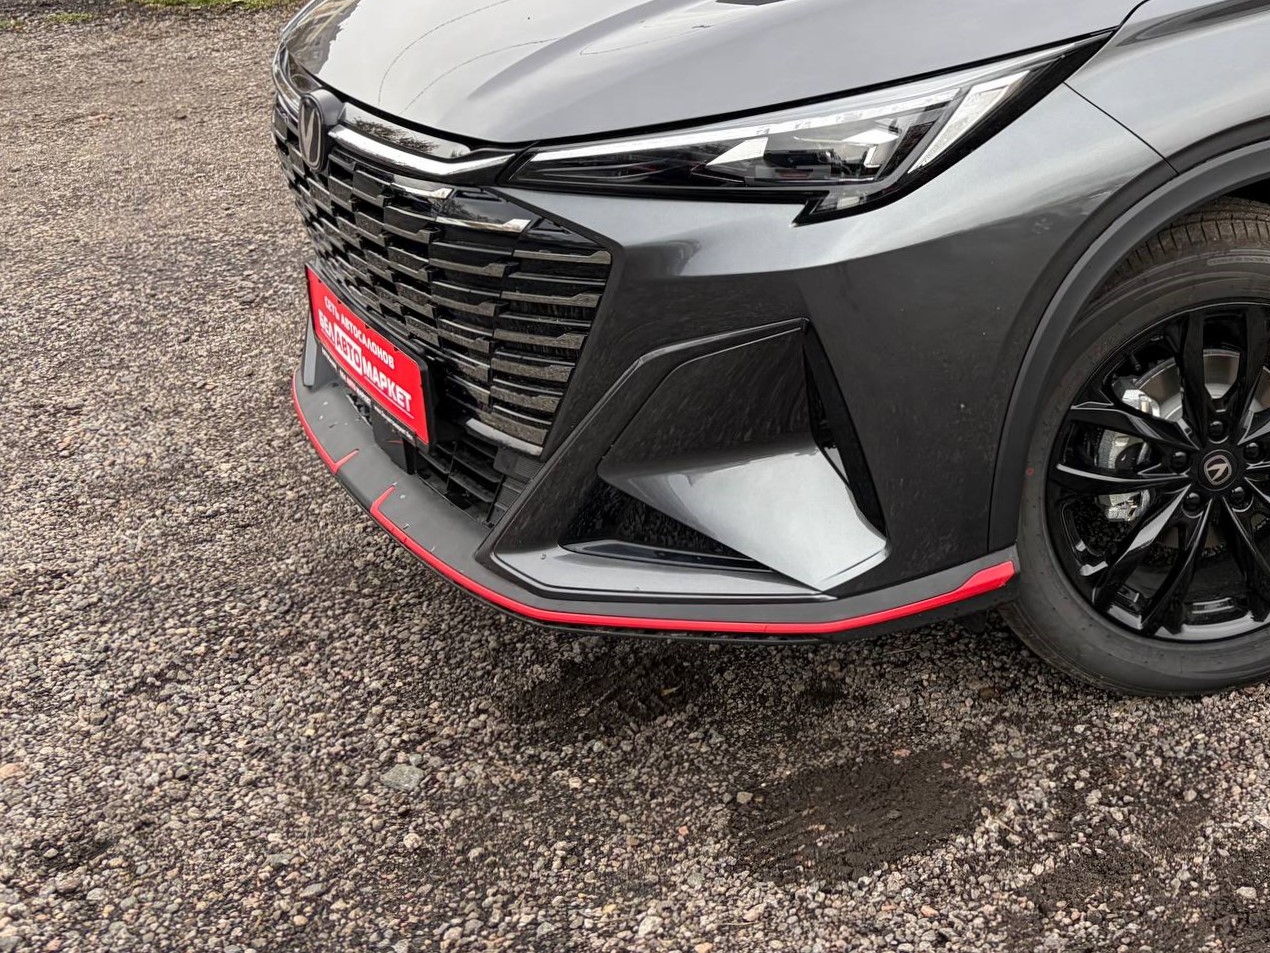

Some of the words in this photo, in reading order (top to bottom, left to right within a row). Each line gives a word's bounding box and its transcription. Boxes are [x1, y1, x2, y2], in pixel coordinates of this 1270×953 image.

[318, 311, 336, 345] БЕЛ
[336, 328, 362, 370] АВТО
[362, 356, 412, 412] МАРКЕТ
[324, 296, 340, 322] СЕТЬ
[341, 313, 395, 370] АВТОСАЛОНОВ
